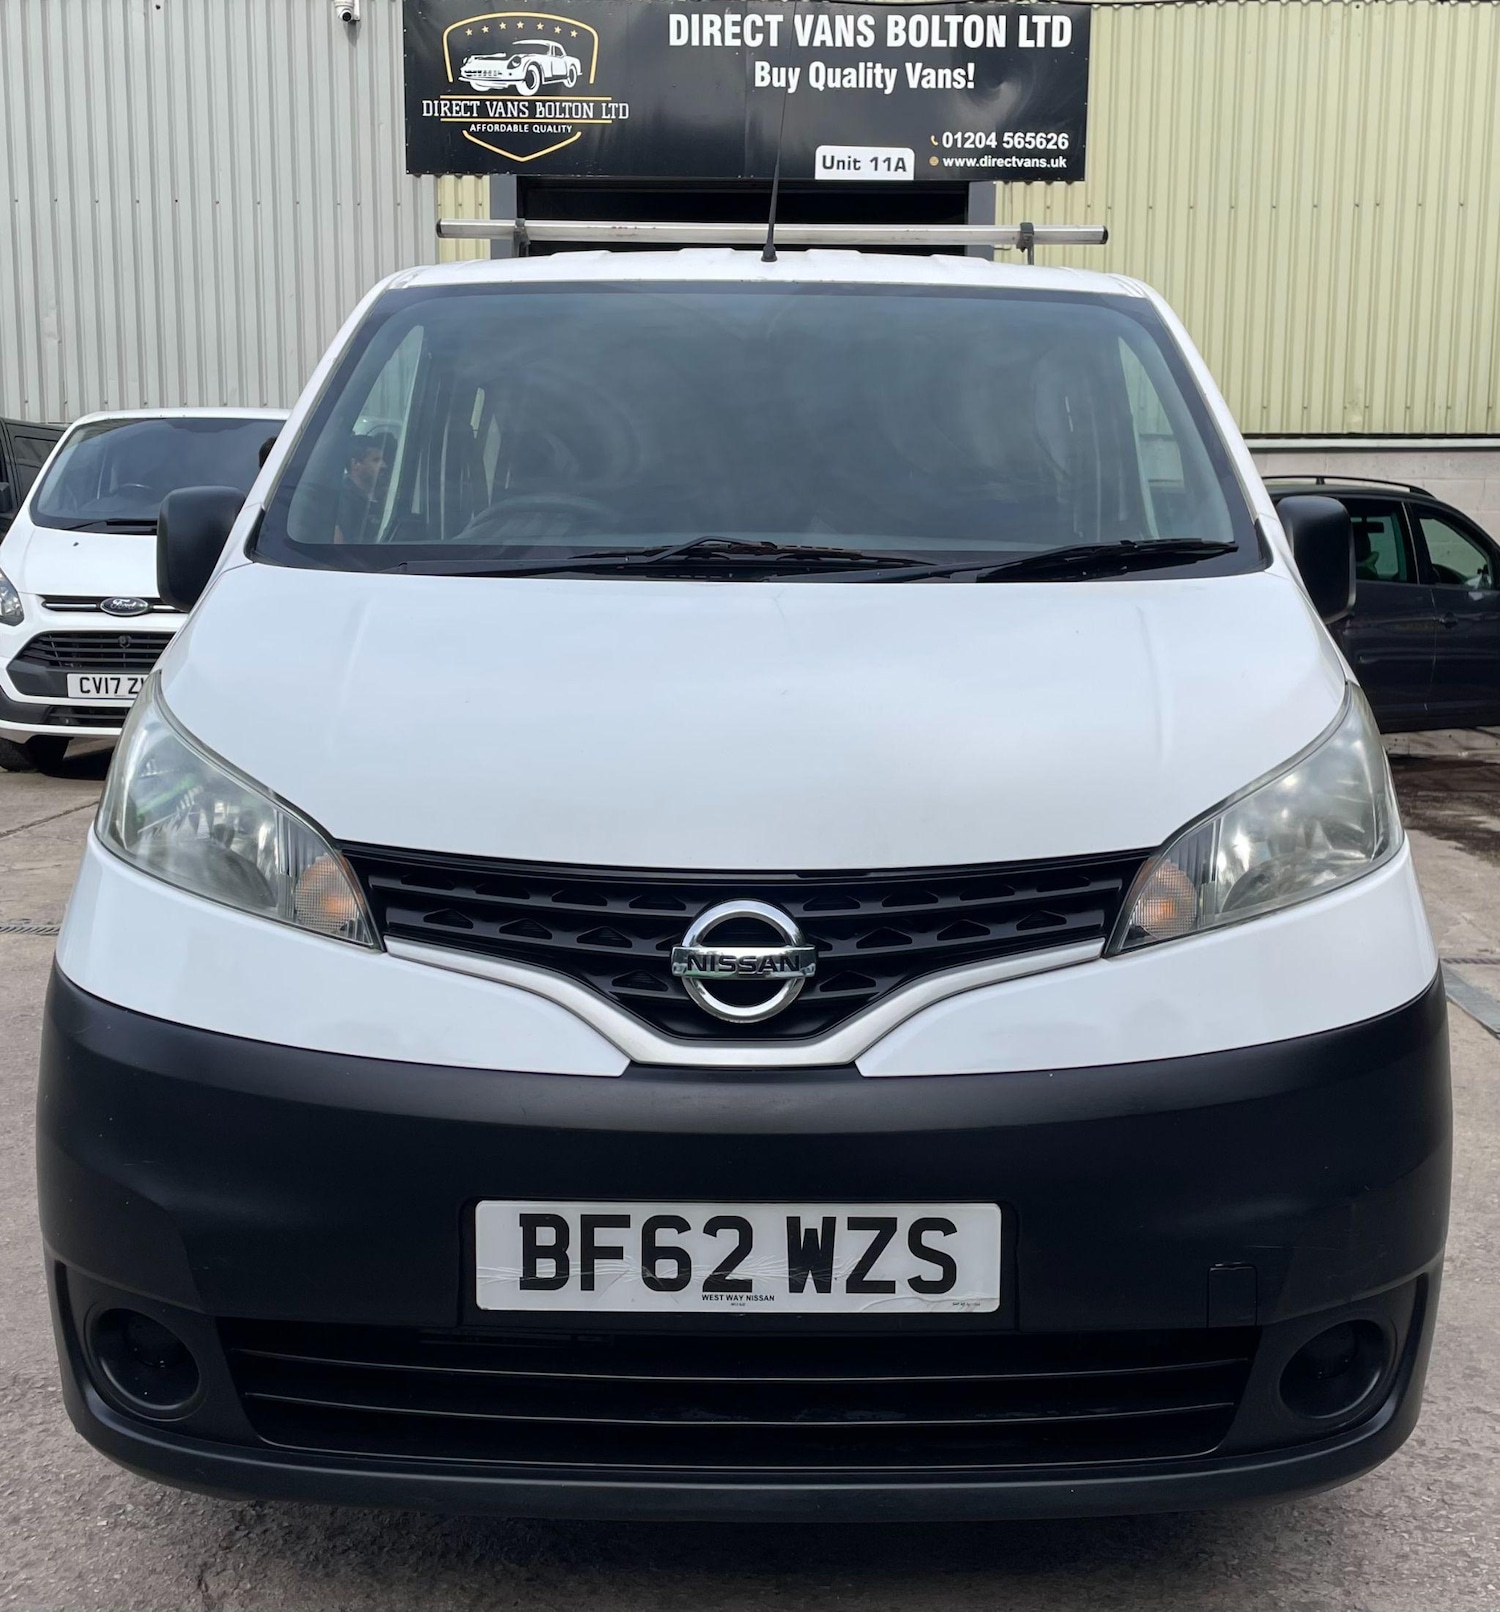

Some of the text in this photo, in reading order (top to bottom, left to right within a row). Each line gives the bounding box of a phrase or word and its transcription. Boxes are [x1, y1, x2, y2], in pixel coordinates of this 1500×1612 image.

[668, 13, 1072, 48] DIRECT VANS BOLTON LTD
[754, 61, 975, 95] Buy Quality Vans!
[422, 100, 629, 119] DIRECT VANS BOLTON LTD
[470, 123, 573, 134] AFFORDABLE QUALITY
[942, 132, 1069, 150] 01204 565626
[821, 154, 907, 173] Unit 11A
[942, 156, 1067, 169] www.directvans.uk
[110, 598, 137, 609] Ford
[79, 677, 121, 695] CV17
[687, 954, 800, 974] NISSAN
[519, 1212, 958, 1295] BF62 WZS
